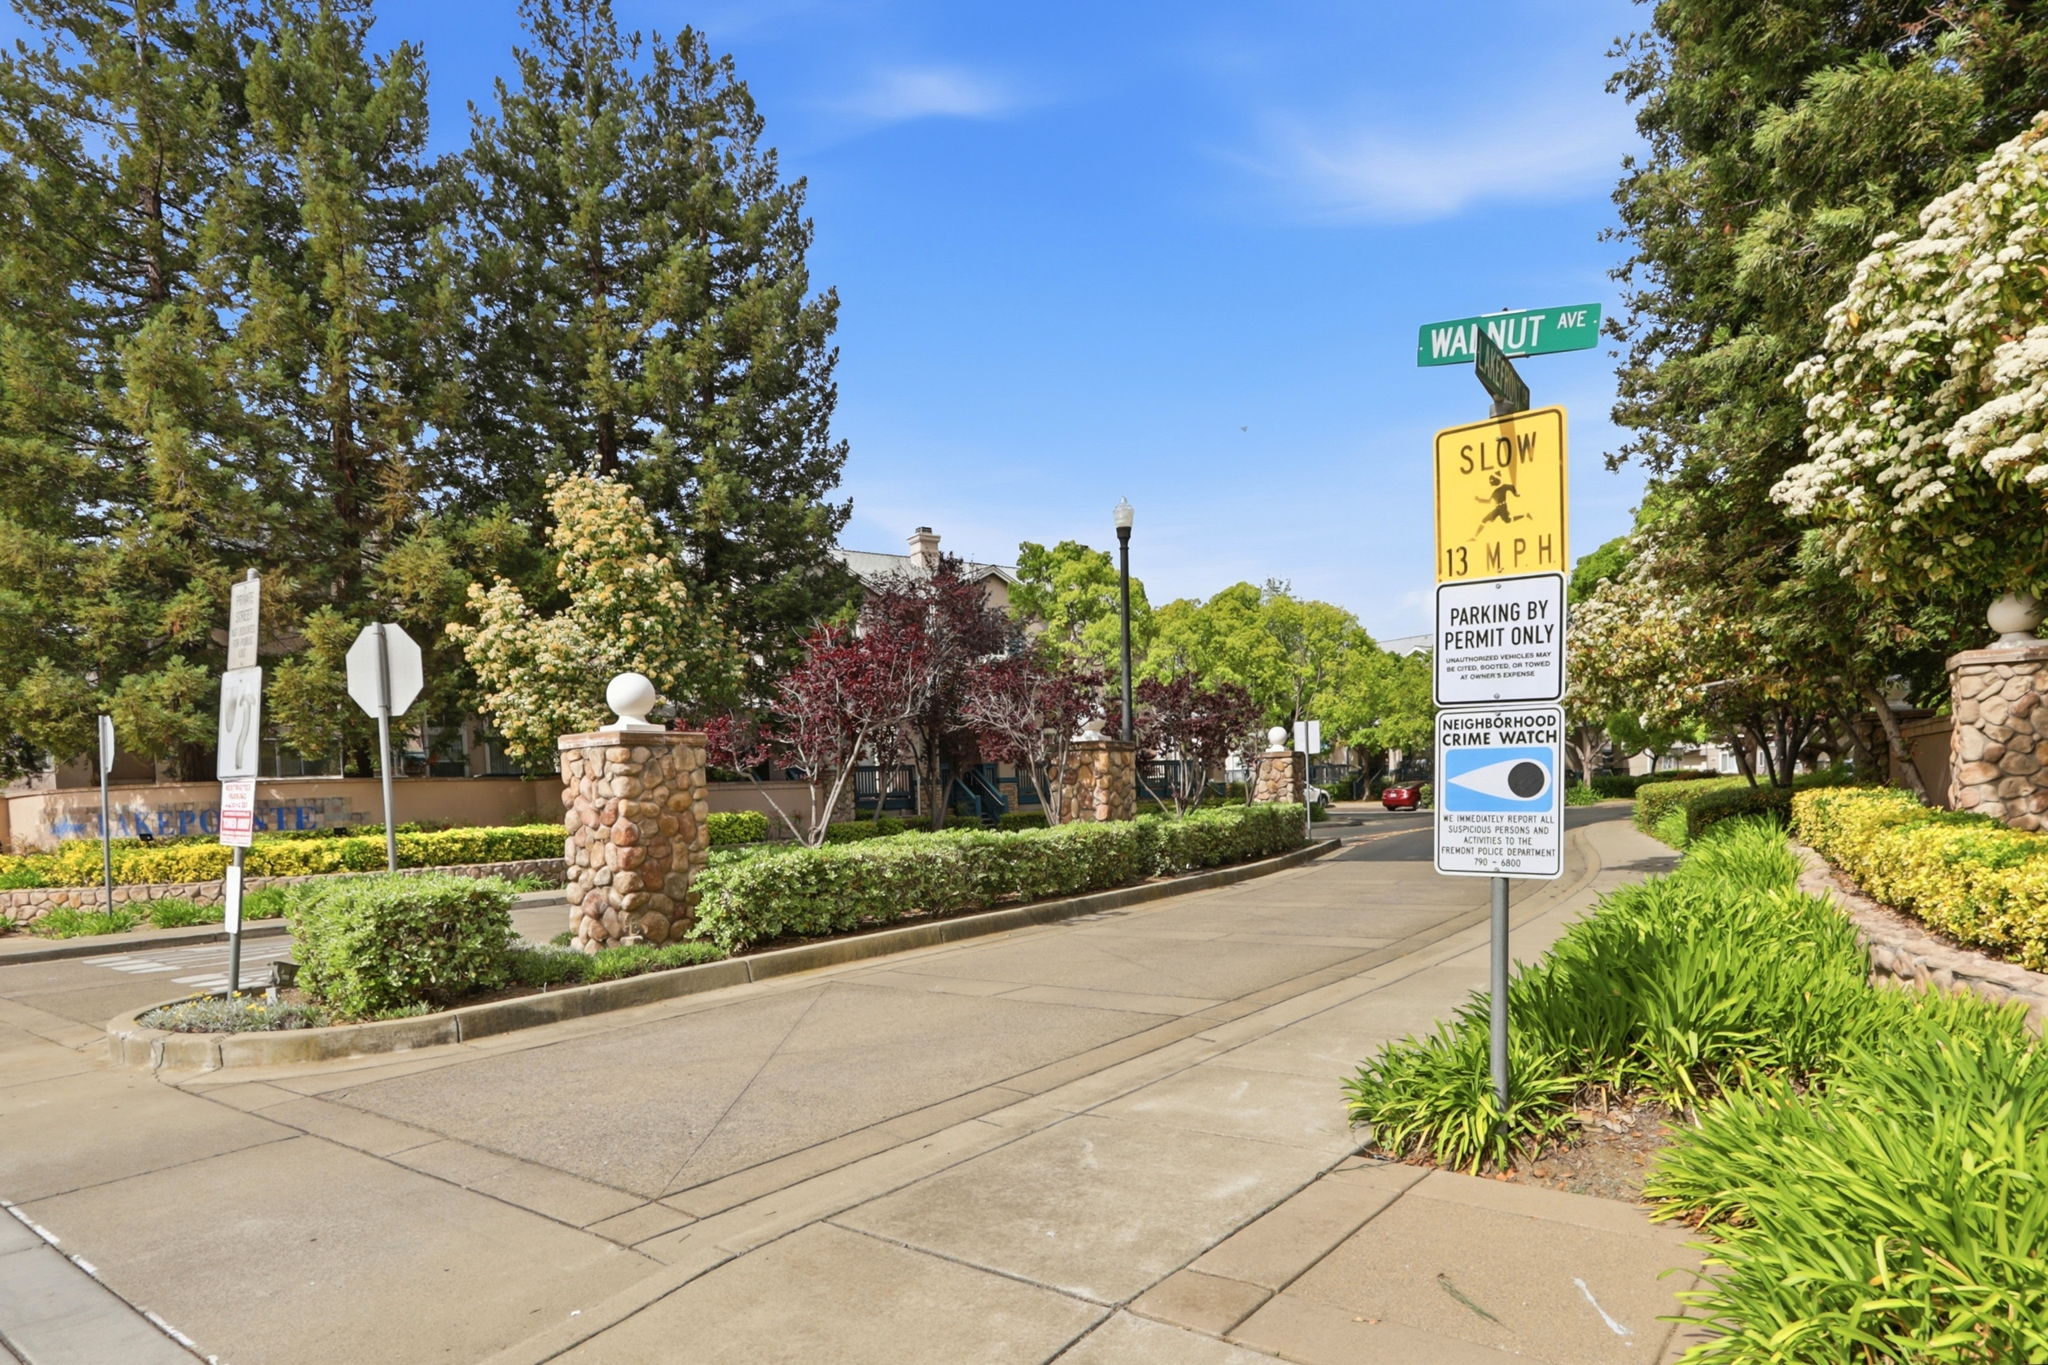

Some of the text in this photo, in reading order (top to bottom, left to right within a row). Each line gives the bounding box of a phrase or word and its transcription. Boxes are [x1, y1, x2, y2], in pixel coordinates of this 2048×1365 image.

[1431, 310, 1587, 359] WALNUT AVE
[1460, 431, 1536, 475] SLOW
[1446, 546, 1468, 577] 13
[1450, 599, 1548, 627] PARKING BY
[1445, 624, 1554, 651] PERMIT ONLY
[1446, 654, 1499, 664] UNAUTHORIZED
[1500, 652, 1534, 660] VEHICLES
[1470, 672, 1502, 680] OWNER'S
[1503, 670, 1535, 678] EXPENSE
[1442, 715, 1556, 731] NEIGHBORHOOD
[1442, 729, 1557, 746] CRIME WATCH
[1443, 814, 1554, 824] WE IMMEDIATELY REPORT ALL
[1448, 825, 1549, 835] SUSPICIOUS PERSONS AND
[1464, 836, 1532, 845] ACTIVITIES TO THE
[1441, 846, 1555, 857] FREMONT POLICE DEPARTMENT
[1474, 858, 1488, 866] 790
[1501, 859, 1521, 867] 6800
